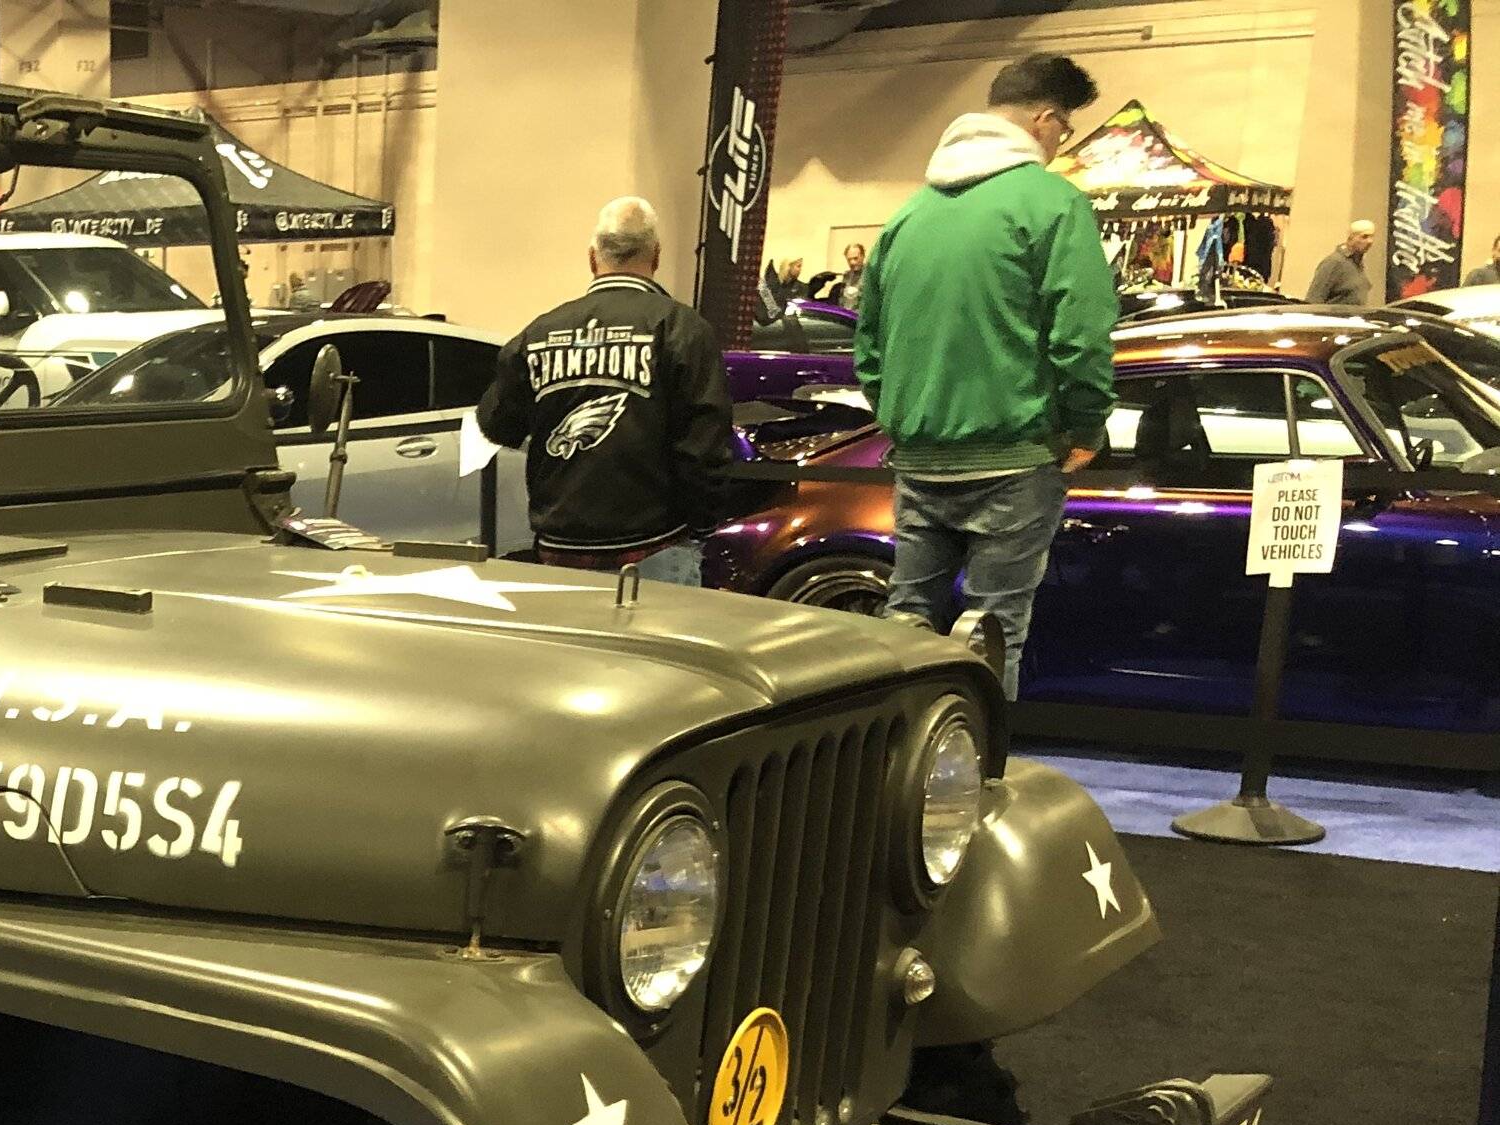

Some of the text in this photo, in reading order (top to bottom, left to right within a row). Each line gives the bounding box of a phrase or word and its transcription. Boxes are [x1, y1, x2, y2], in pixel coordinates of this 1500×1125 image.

[526, 345, 652, 392] CHAMPIONS
[1277, 488, 1320, 503] PLEASE
[1272, 505, 1321, 522] DO NOT
[1273, 525, 1317, 541] TOUCH
[1261, 544, 1324, 560] VEHICLES
